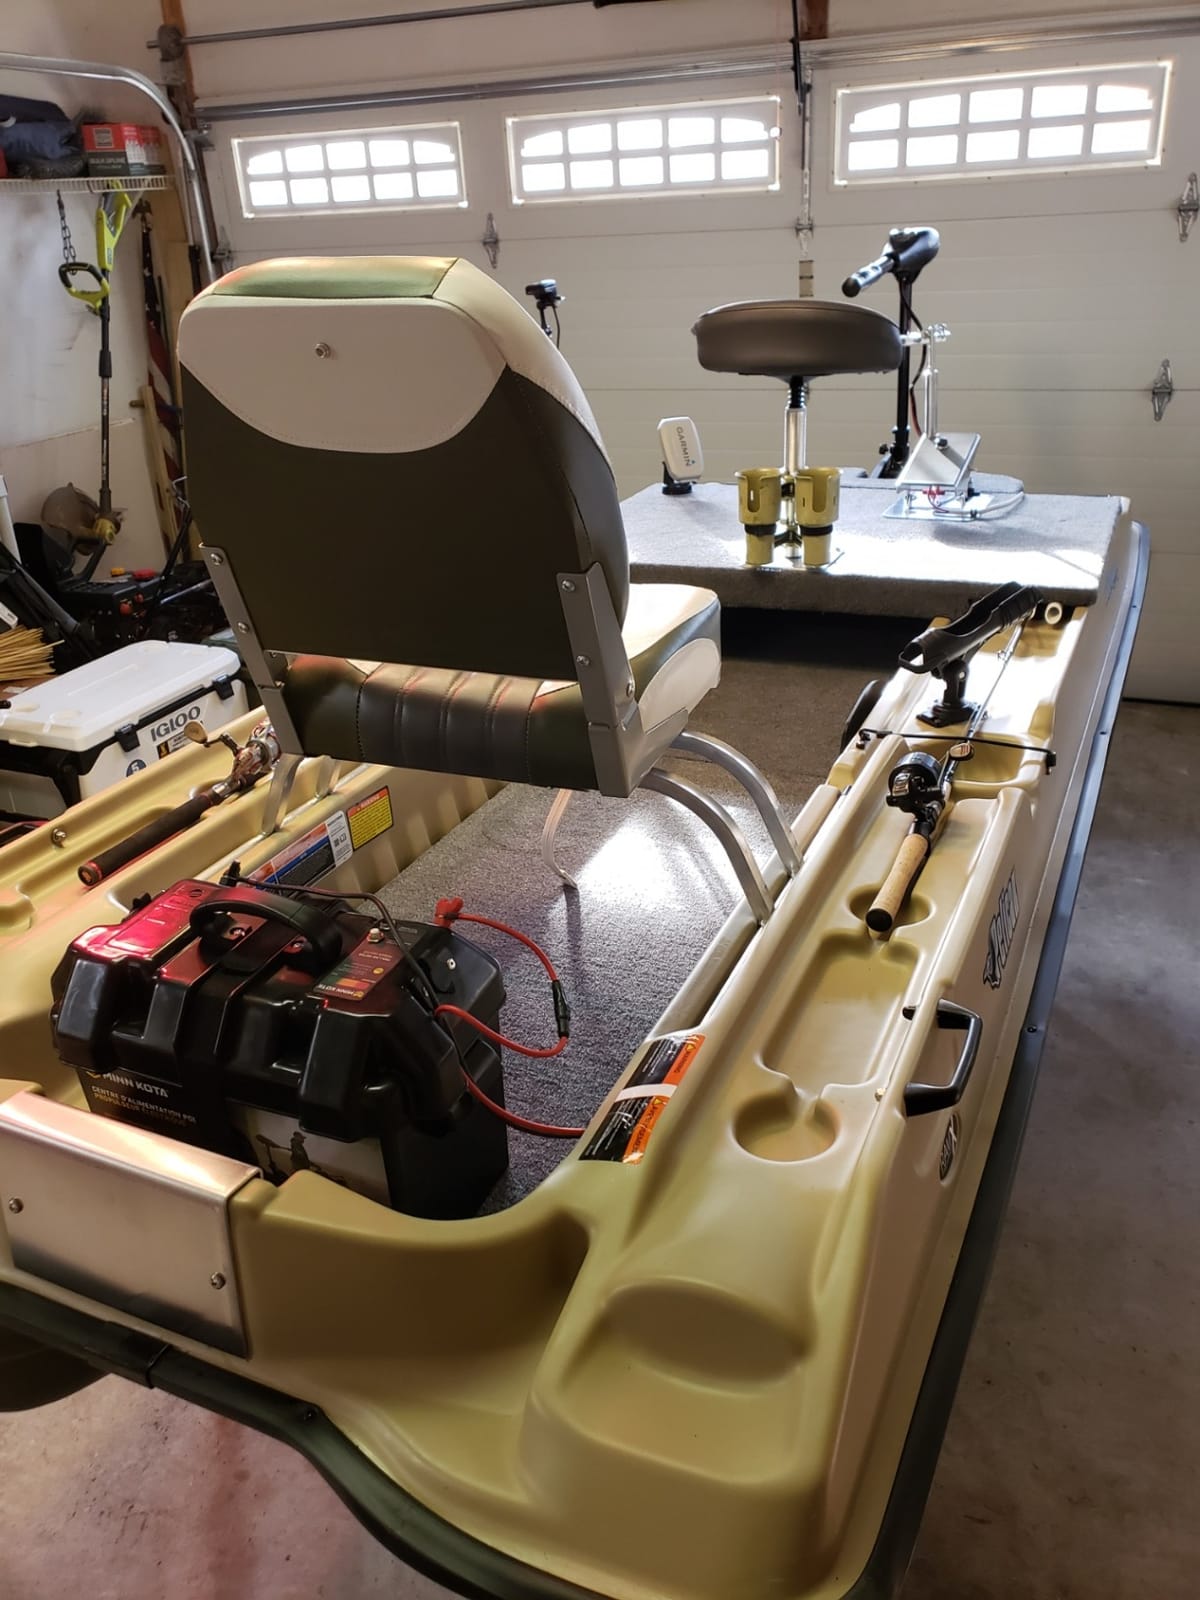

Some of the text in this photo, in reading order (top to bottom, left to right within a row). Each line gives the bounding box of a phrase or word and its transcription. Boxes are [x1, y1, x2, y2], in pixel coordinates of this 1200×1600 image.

[676, 426, 692, 467] GARMIN
[150, 705, 201, 742] IGLOO
[91, 1084, 119, 1100] CENTRE
[120, 1094, 181, 1119] D'ALIMENTATION
[102, 1072, 169, 1099] MINN KOTA
